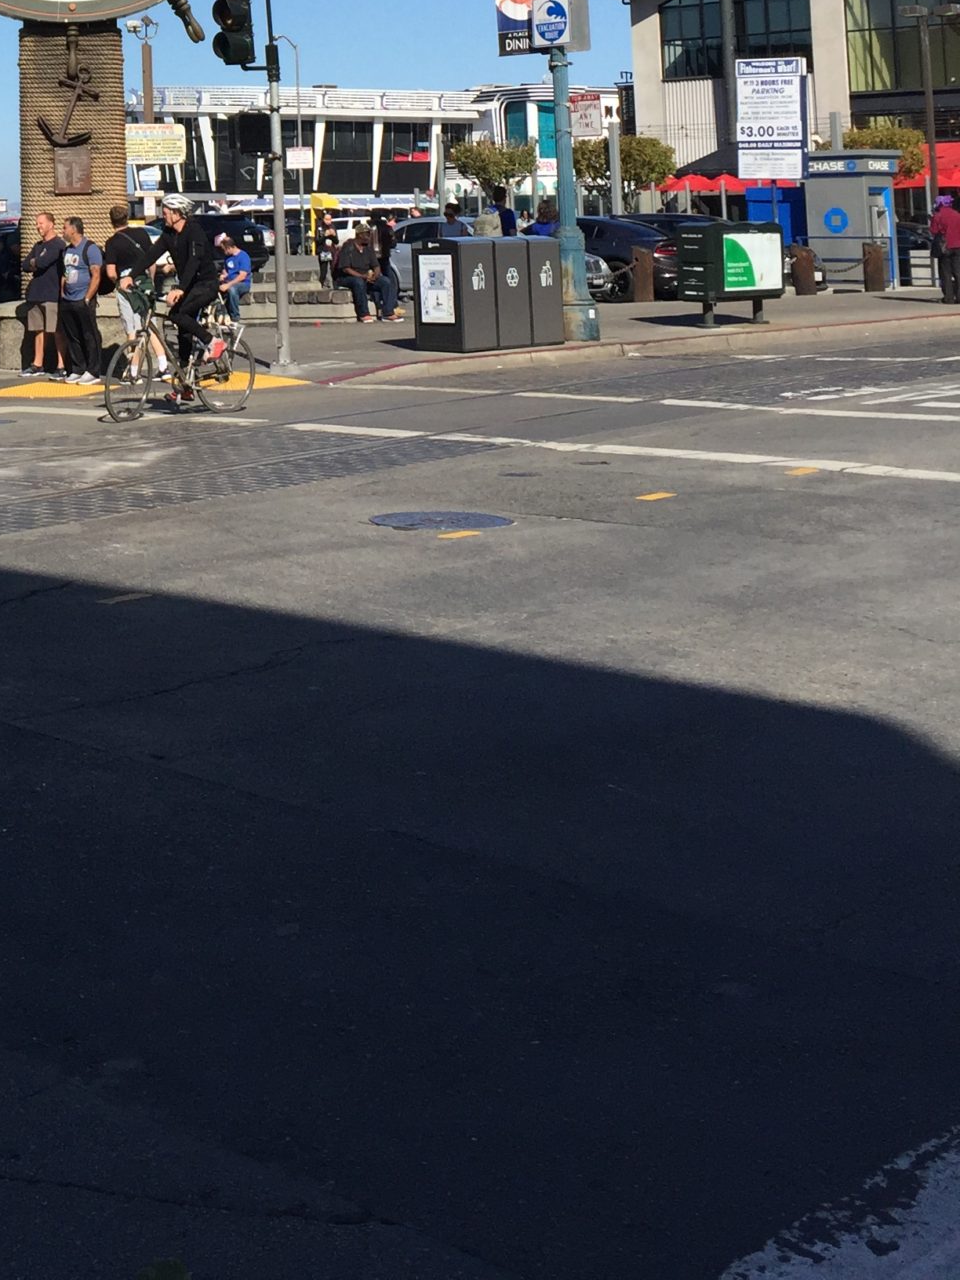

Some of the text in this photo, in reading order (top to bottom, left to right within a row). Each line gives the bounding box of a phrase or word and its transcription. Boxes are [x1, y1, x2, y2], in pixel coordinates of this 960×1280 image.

[538, 22, 565, 31] EVACUATION
[740, 125, 775, 137] $3.00
[868, 161, 889, 170] CHASE
